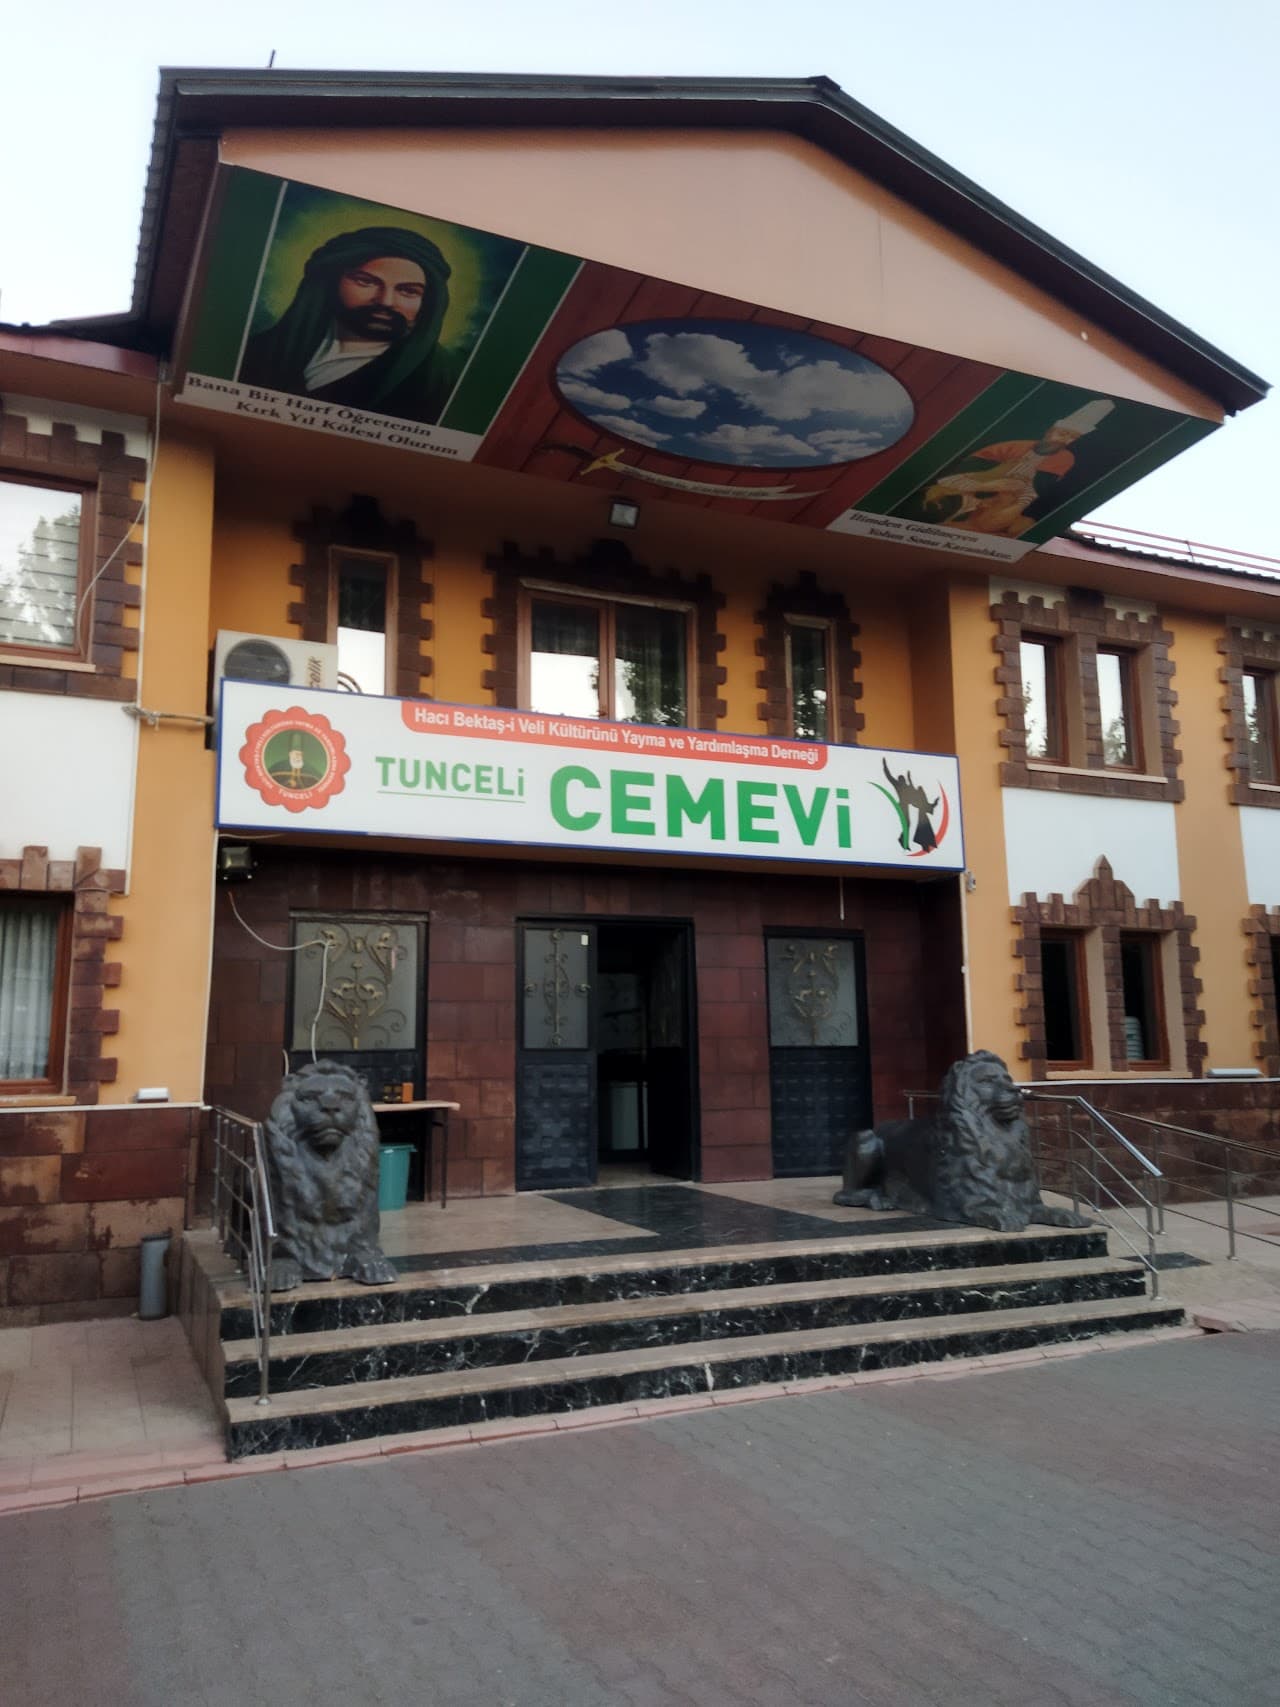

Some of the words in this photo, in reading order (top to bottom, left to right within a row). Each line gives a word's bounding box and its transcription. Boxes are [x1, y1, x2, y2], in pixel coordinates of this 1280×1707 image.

[186, 376, 241, 397] Bana
[248, 389, 279, 404] Bir
[286, 397, 334, 415] Harf
[337, 406, 432, 437] Öğretenin
[235, 401, 281, 418] Kırk
[288, 411, 315, 427] Yıl
[321, 418, 383, 441] Kölesi
[387, 433, 459, 456] Olurum
[414, 707, 449, 725] Hacı
[453, 711, 515, 734] Bektaş-i
[519, 718, 545, 735] Veli
[549, 722, 618, 743] Kültürünü
[621, 729, 666, 748] Yayma
[669, 738, 684, 749] ve
[687, 736, 768, 759] Yardımlaşma
[771, 744, 819, 764] Derneği
